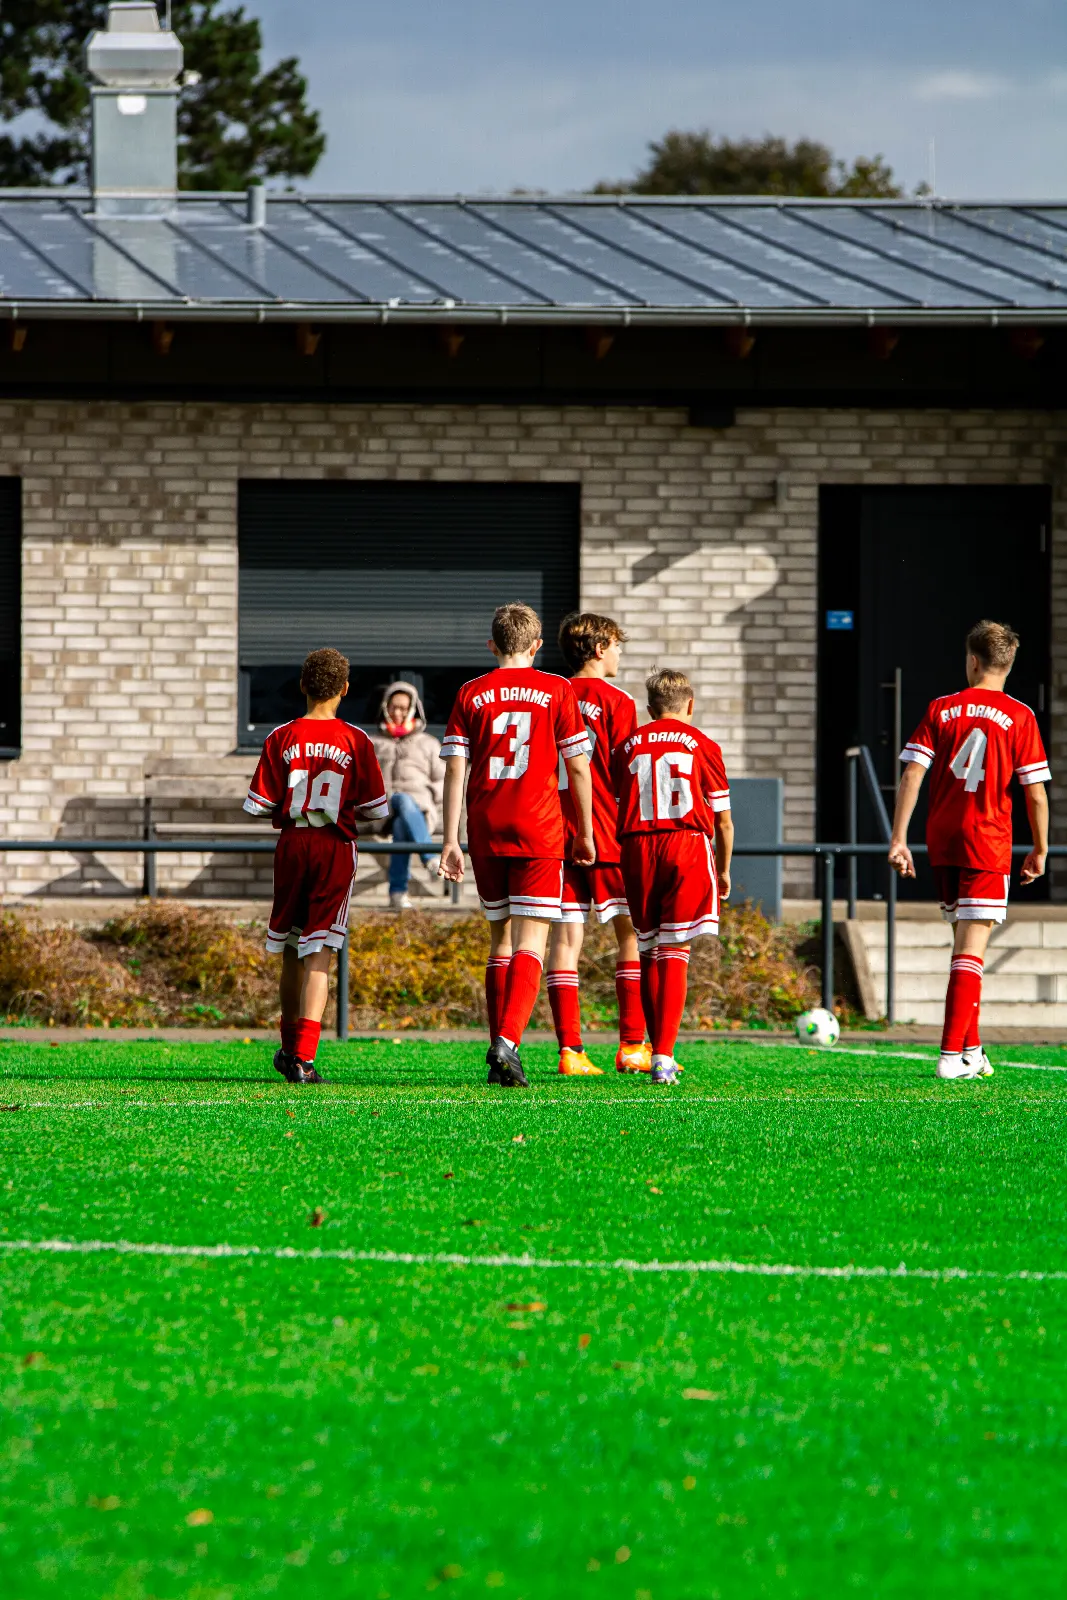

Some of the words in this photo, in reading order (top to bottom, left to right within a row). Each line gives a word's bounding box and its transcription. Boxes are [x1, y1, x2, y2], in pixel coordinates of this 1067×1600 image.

[472, 689, 496, 710] RW
[500, 687, 552, 708] DAMME
[940, 705, 963, 723] RW
[966, 703, 1014, 731] DAMME
[282, 743, 301, 765] RW
[305, 742, 353, 770] DAMME
[489, 711, 532, 780] 3
[624, 733, 642, 754] RW
[648, 732, 699, 752] DAMME
[949, 727, 988, 793] 4
[628, 751, 694, 822] 16
